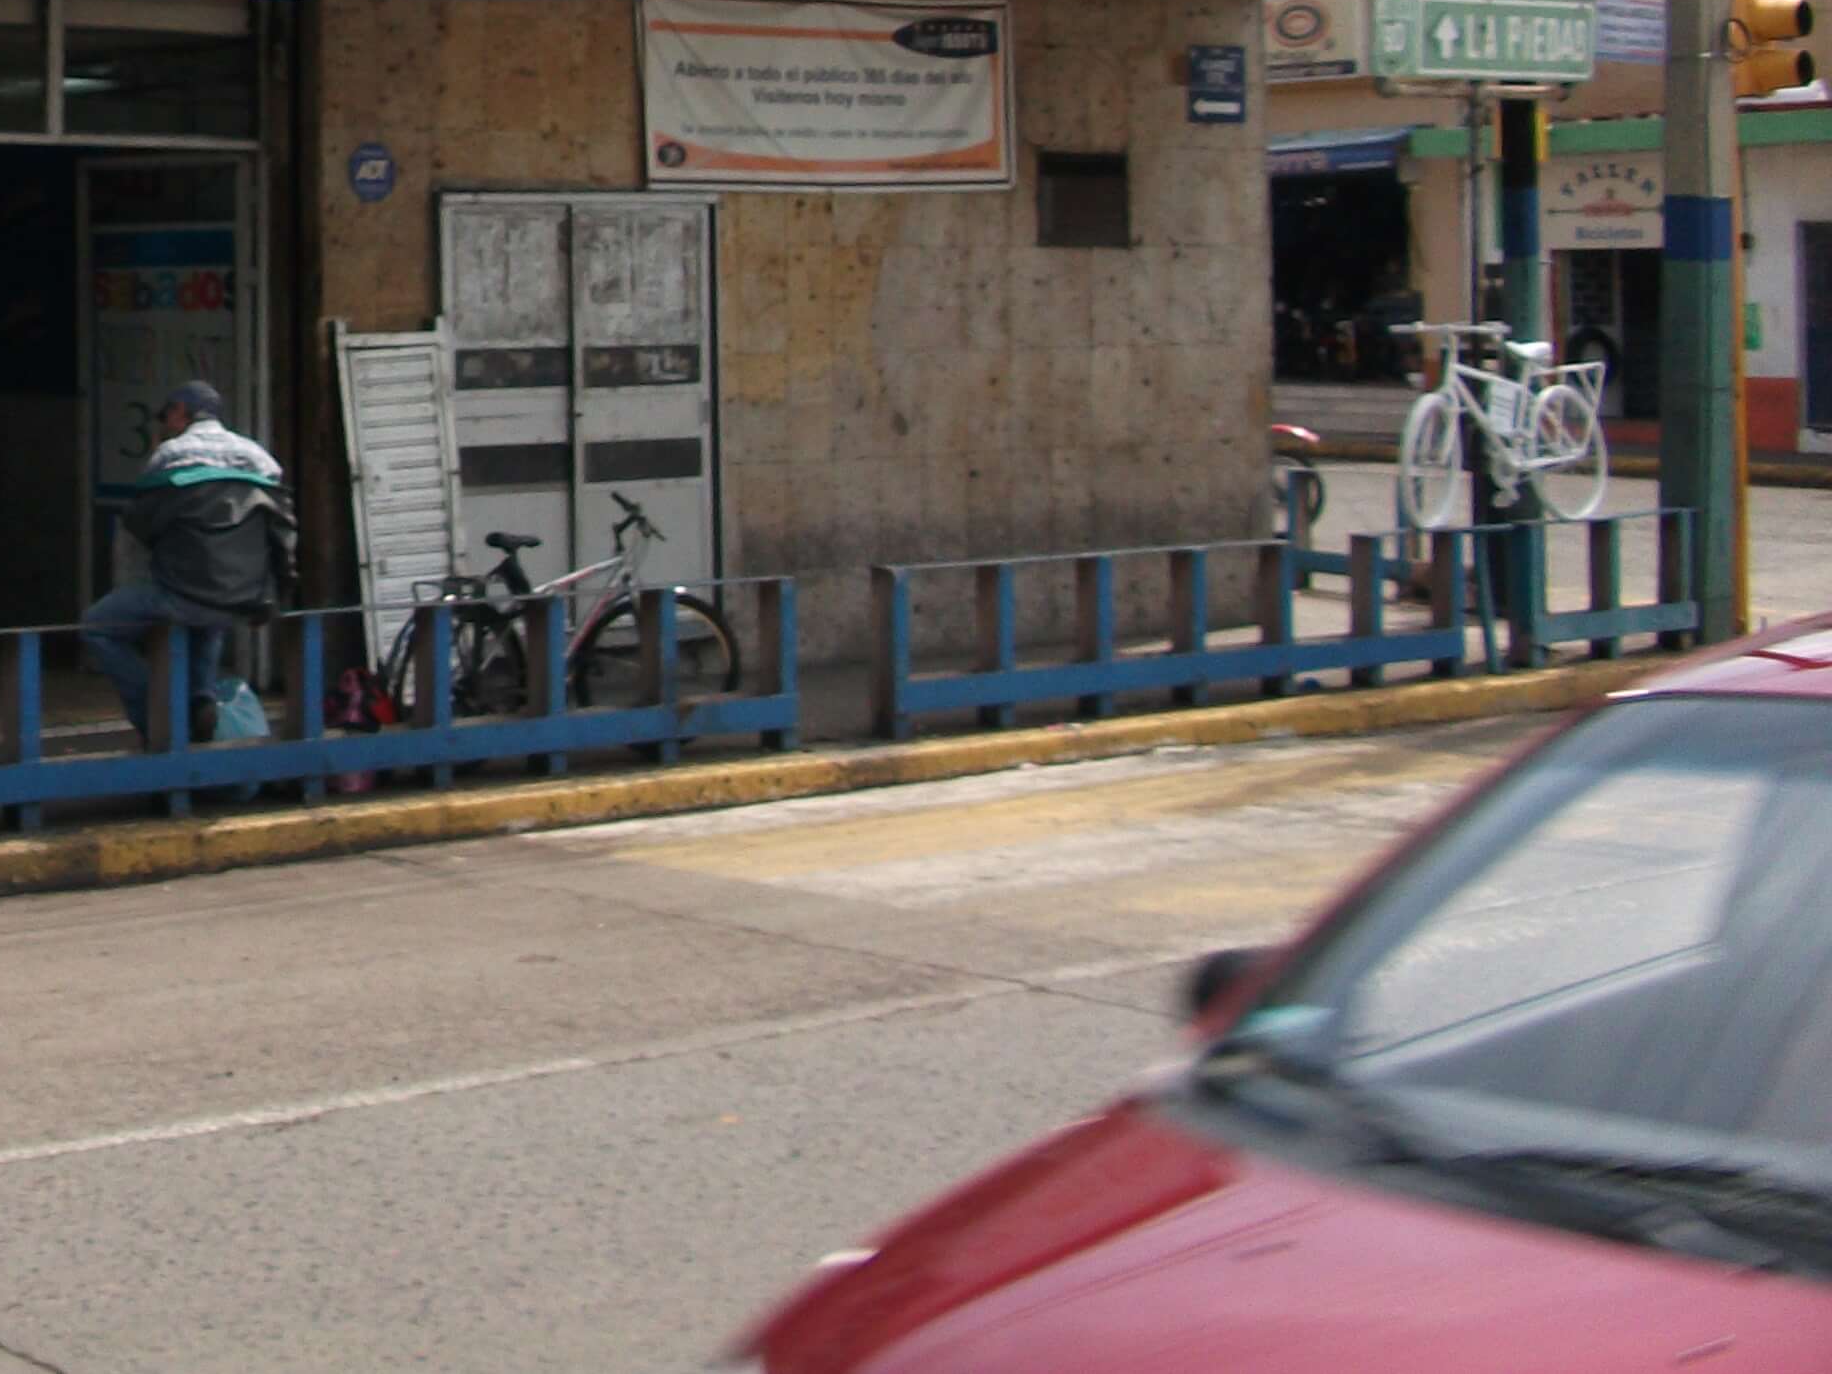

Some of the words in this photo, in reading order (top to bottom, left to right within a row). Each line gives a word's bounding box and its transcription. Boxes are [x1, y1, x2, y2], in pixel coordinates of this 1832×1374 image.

[1464, 12, 1497, 59] LA
[1506, 14, 1587, 62] PIEDAD
[747, 65, 782, 81] todo
[824, 90, 853, 108] hoy
